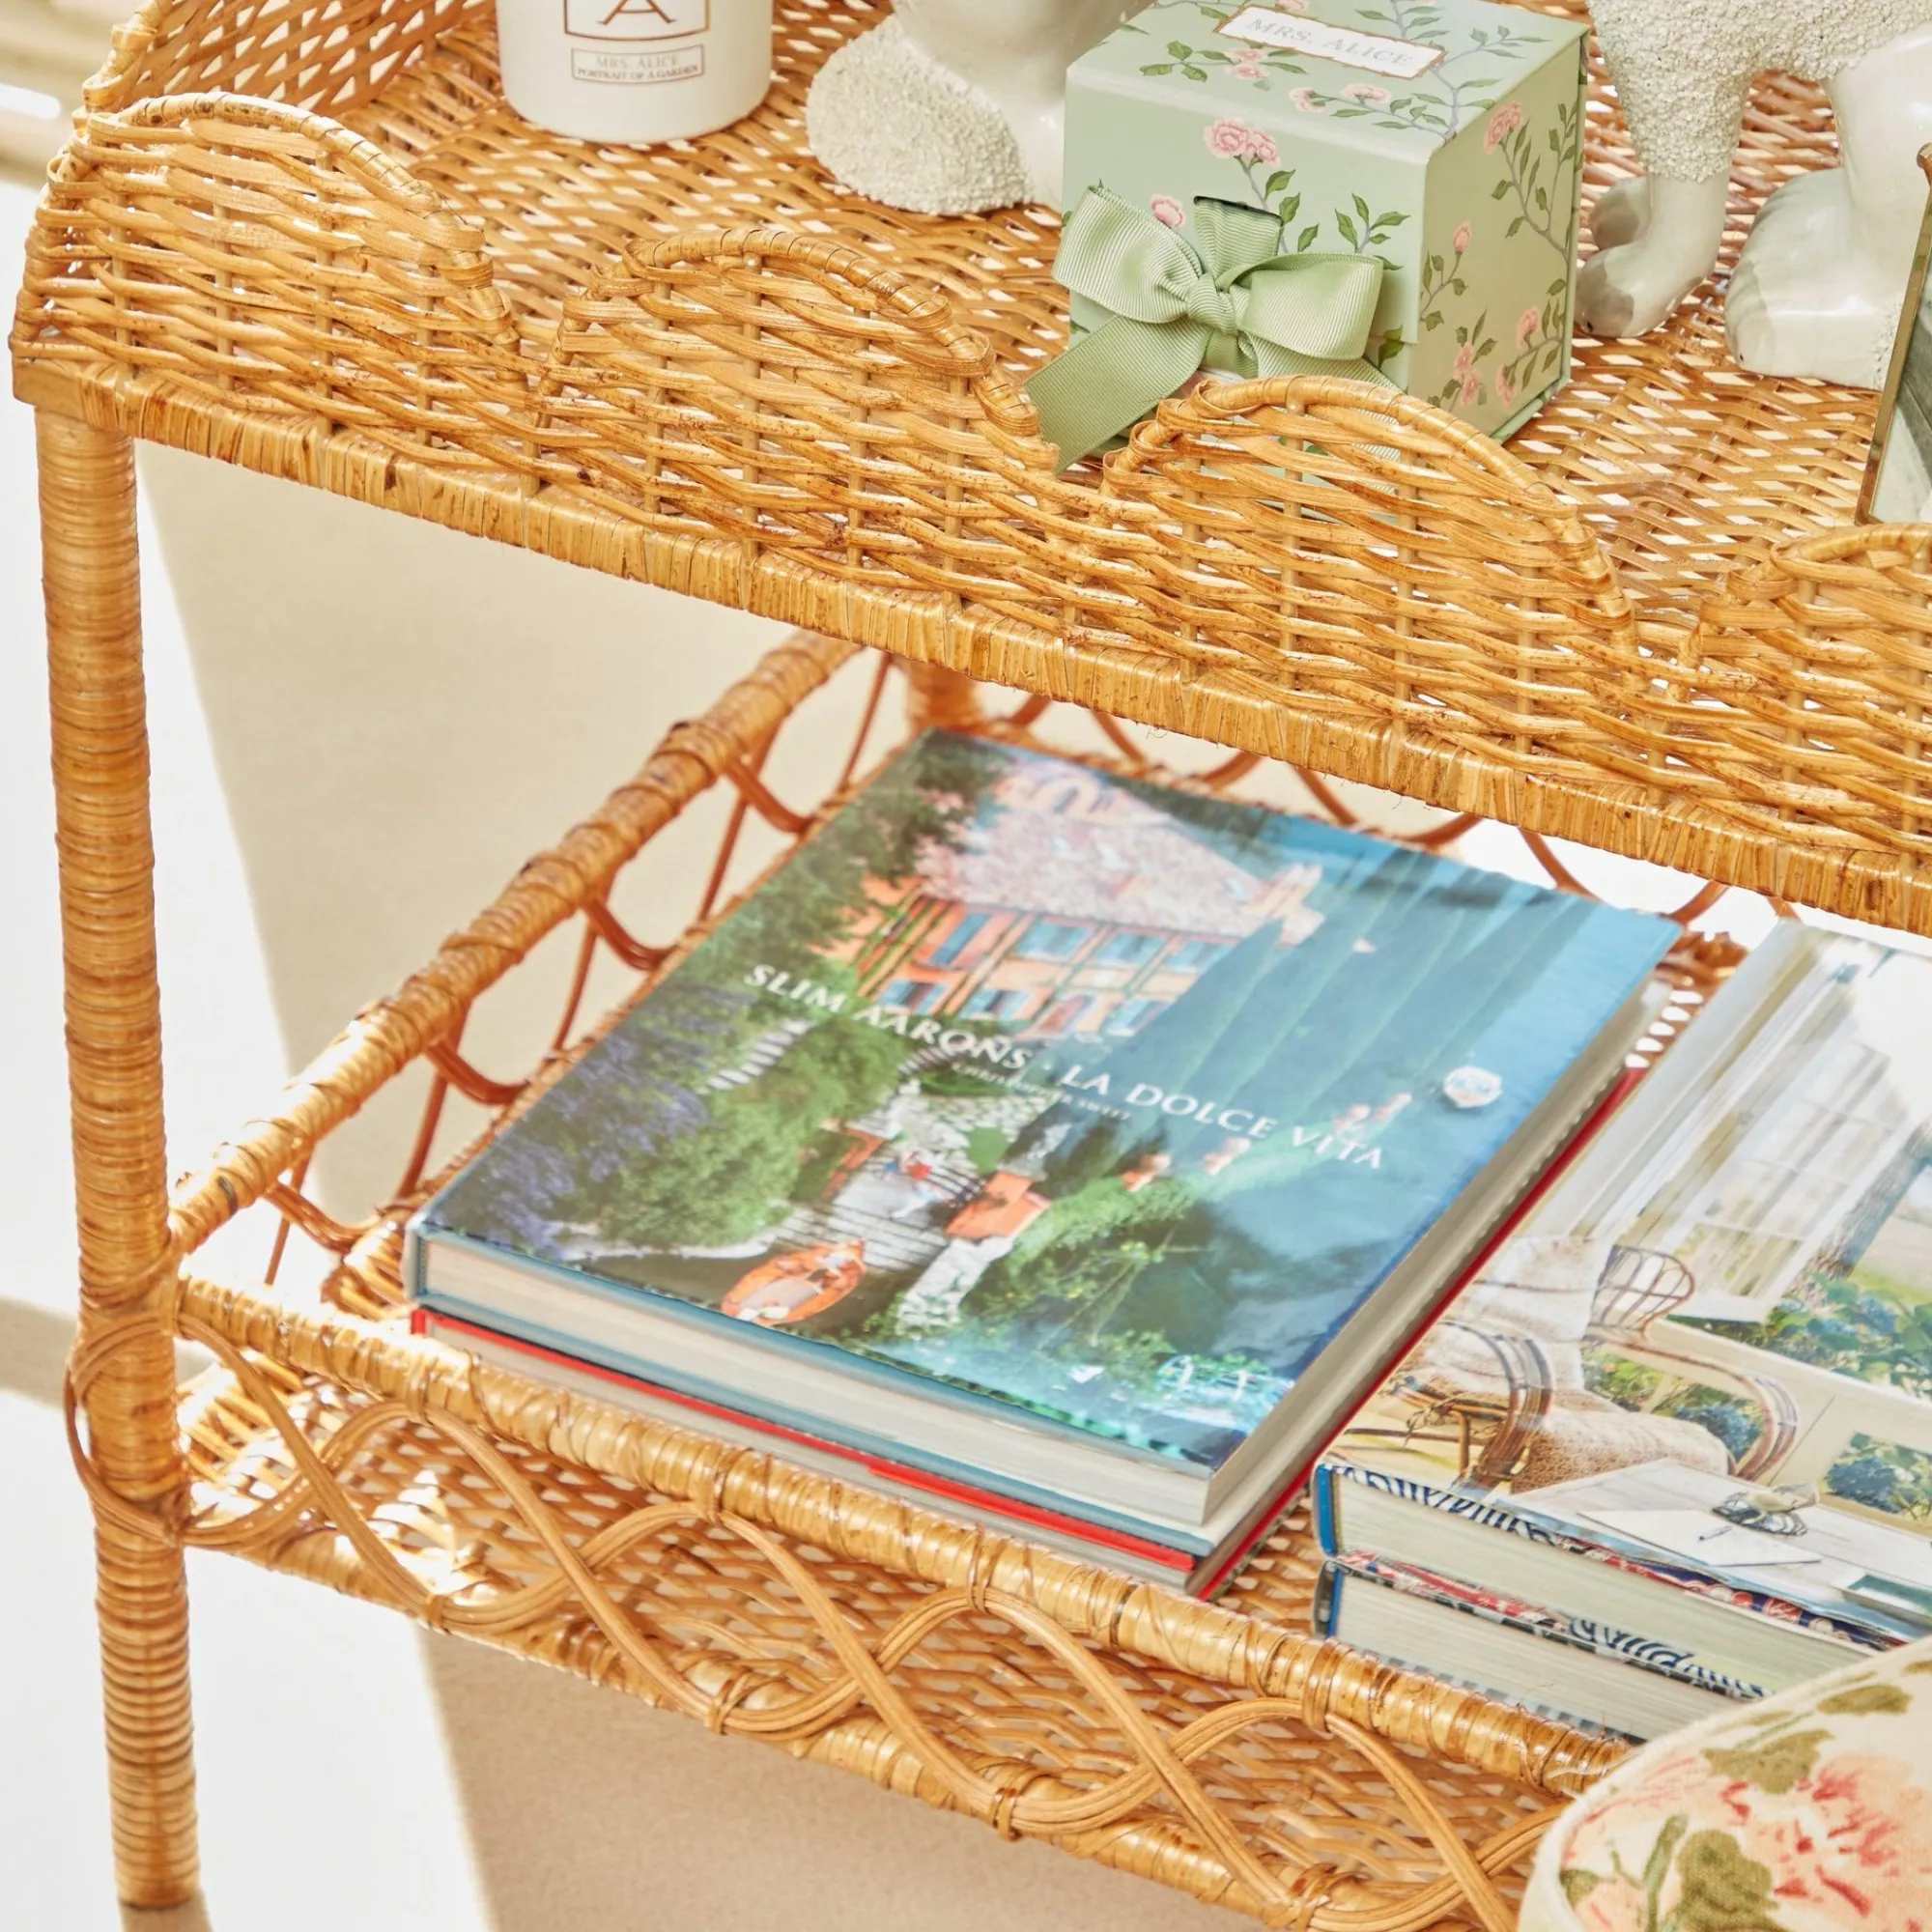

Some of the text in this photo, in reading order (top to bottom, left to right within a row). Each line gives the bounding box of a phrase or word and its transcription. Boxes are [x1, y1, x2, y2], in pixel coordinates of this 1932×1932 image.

[596, 54, 678, 70] MRS. ALICE
[1247, 16, 1412, 66] MRS. ALICE
[744, 963, 847, 1013] SLIM
[851, 1005, 1033, 1070] AARONS
[1057, 1064, 1112, 1096] LA
[1124, 1082, 1279, 1140] DOLCE
[1292, 1124, 1384, 1170] VITA
